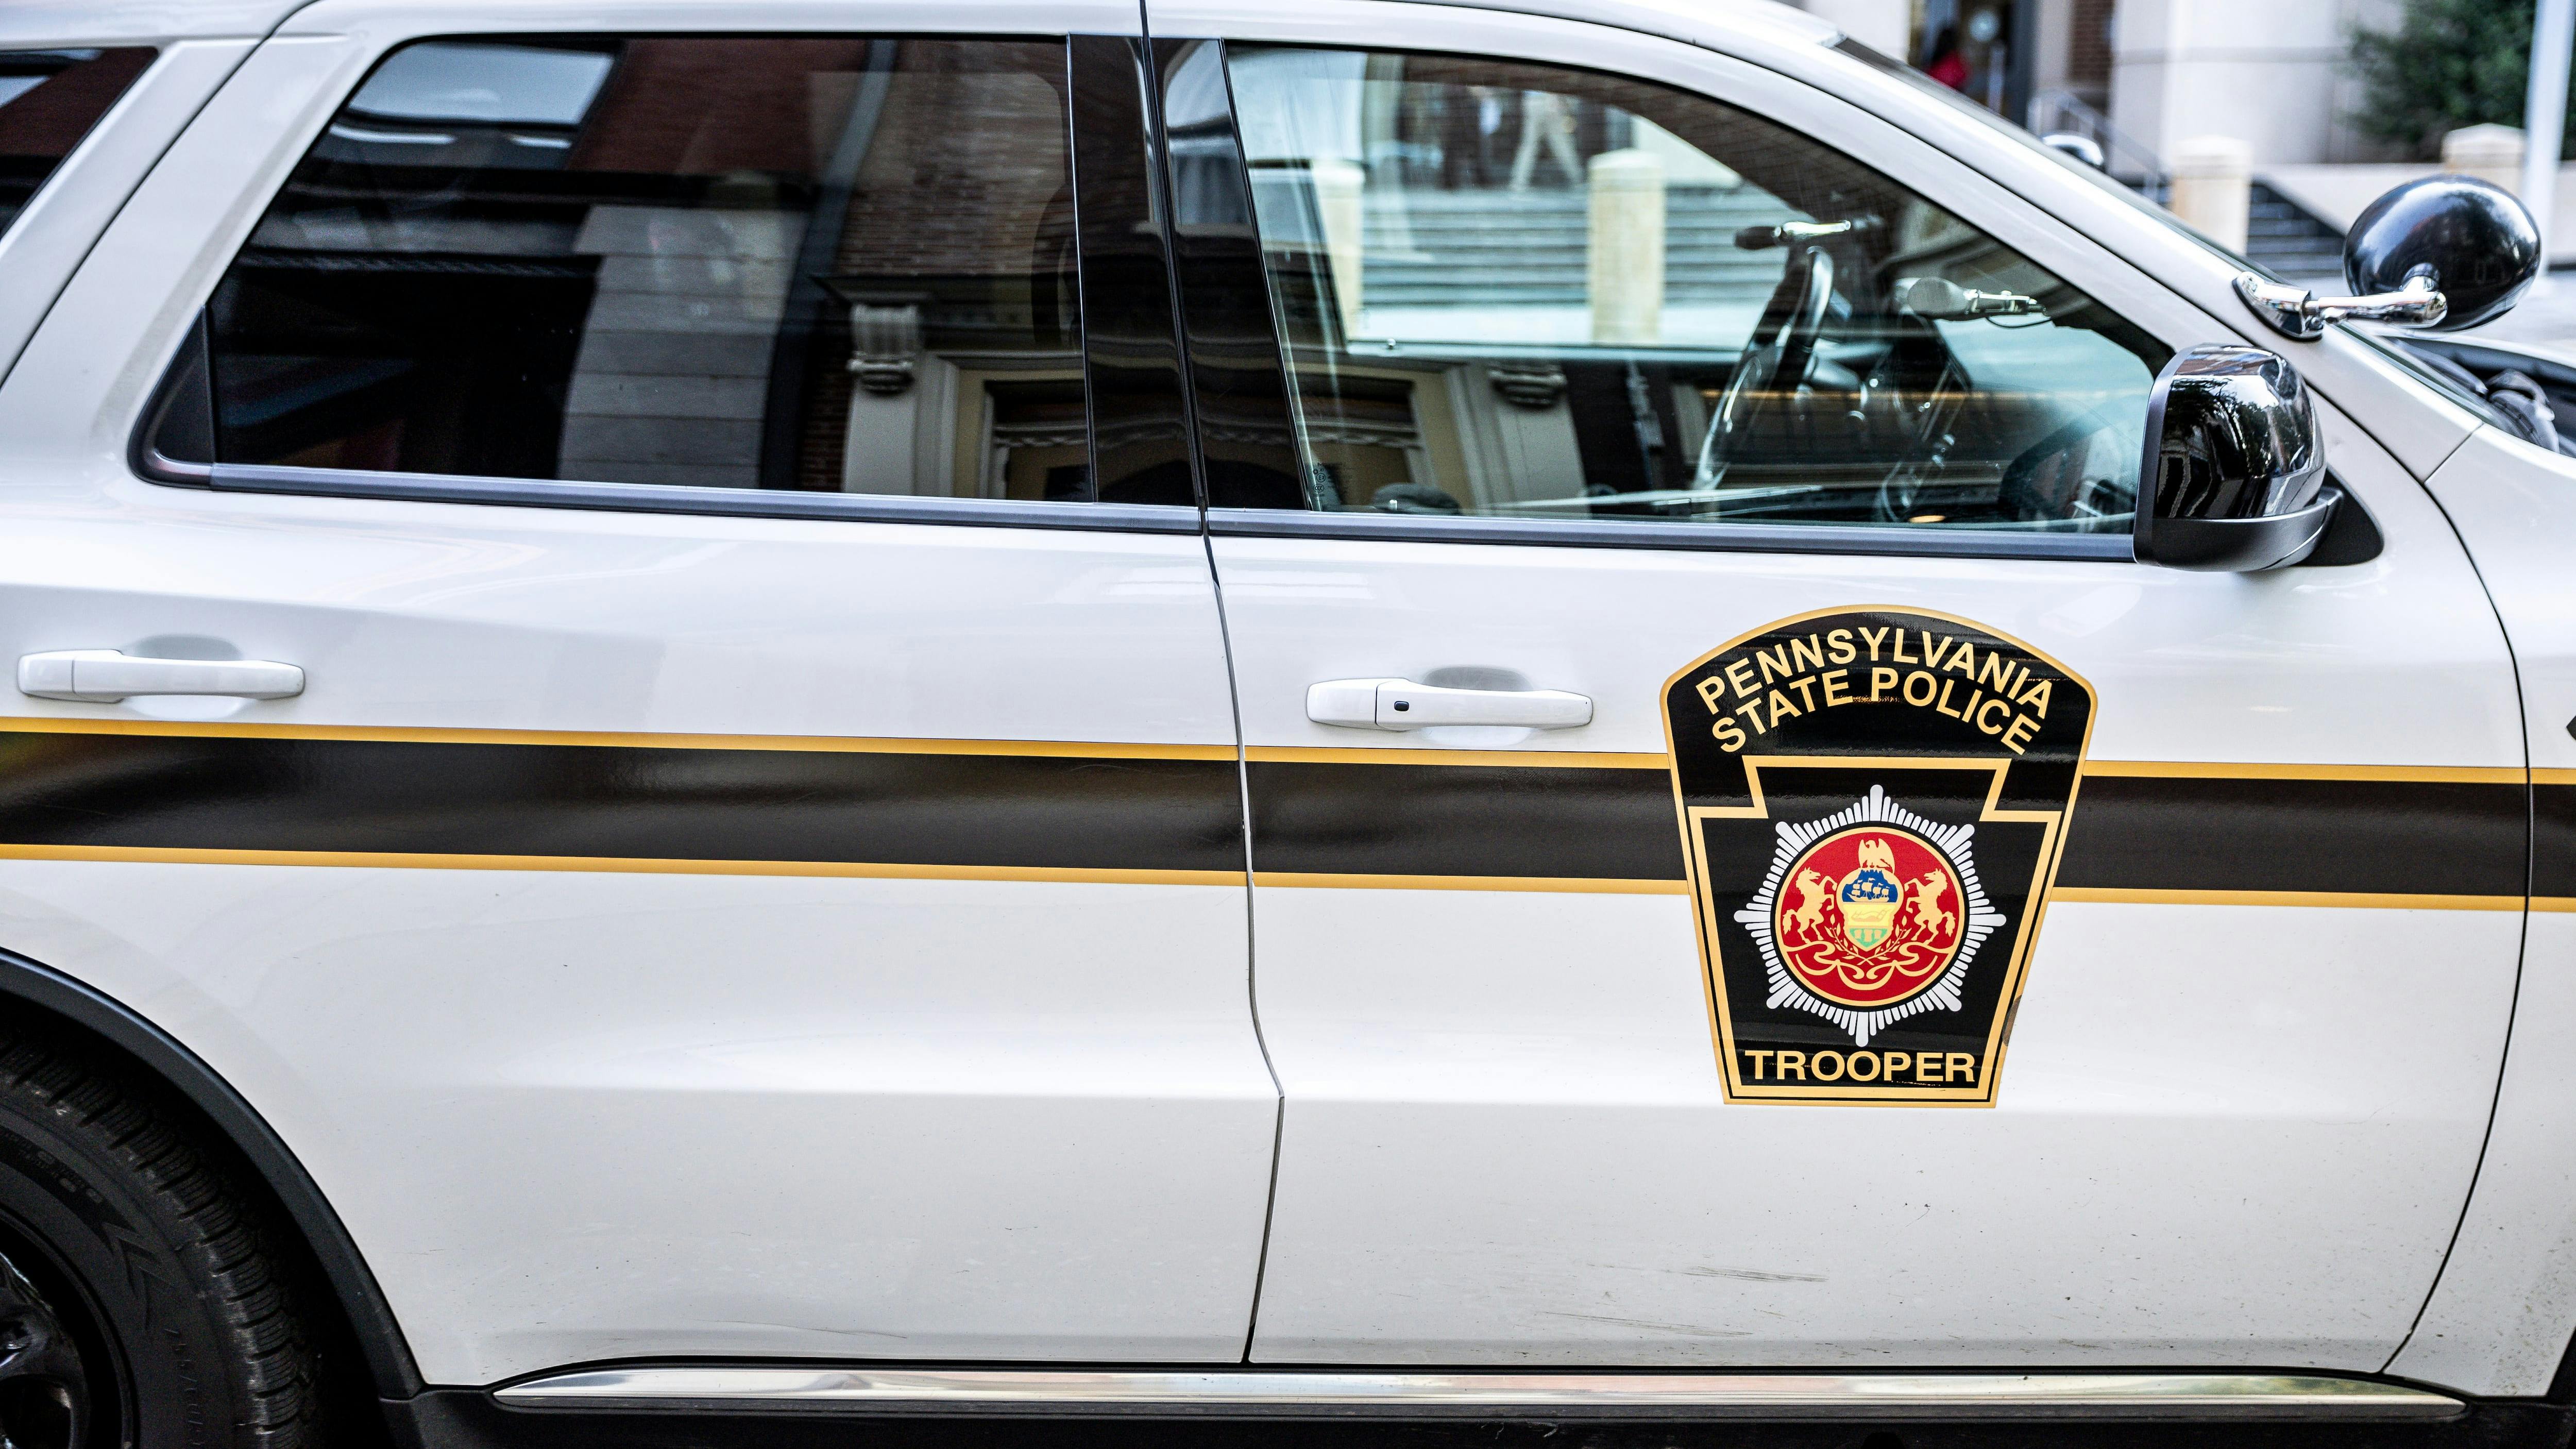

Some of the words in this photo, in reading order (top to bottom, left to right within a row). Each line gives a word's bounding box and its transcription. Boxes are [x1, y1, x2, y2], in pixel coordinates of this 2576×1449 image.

[1696, 627, 2053, 719] PENNSYLVANIA
[1713, 668, 1854, 752] STATE
[1861, 667, 2041, 755] POLICE
[1744, 1050, 1975, 1082] TROOPER
